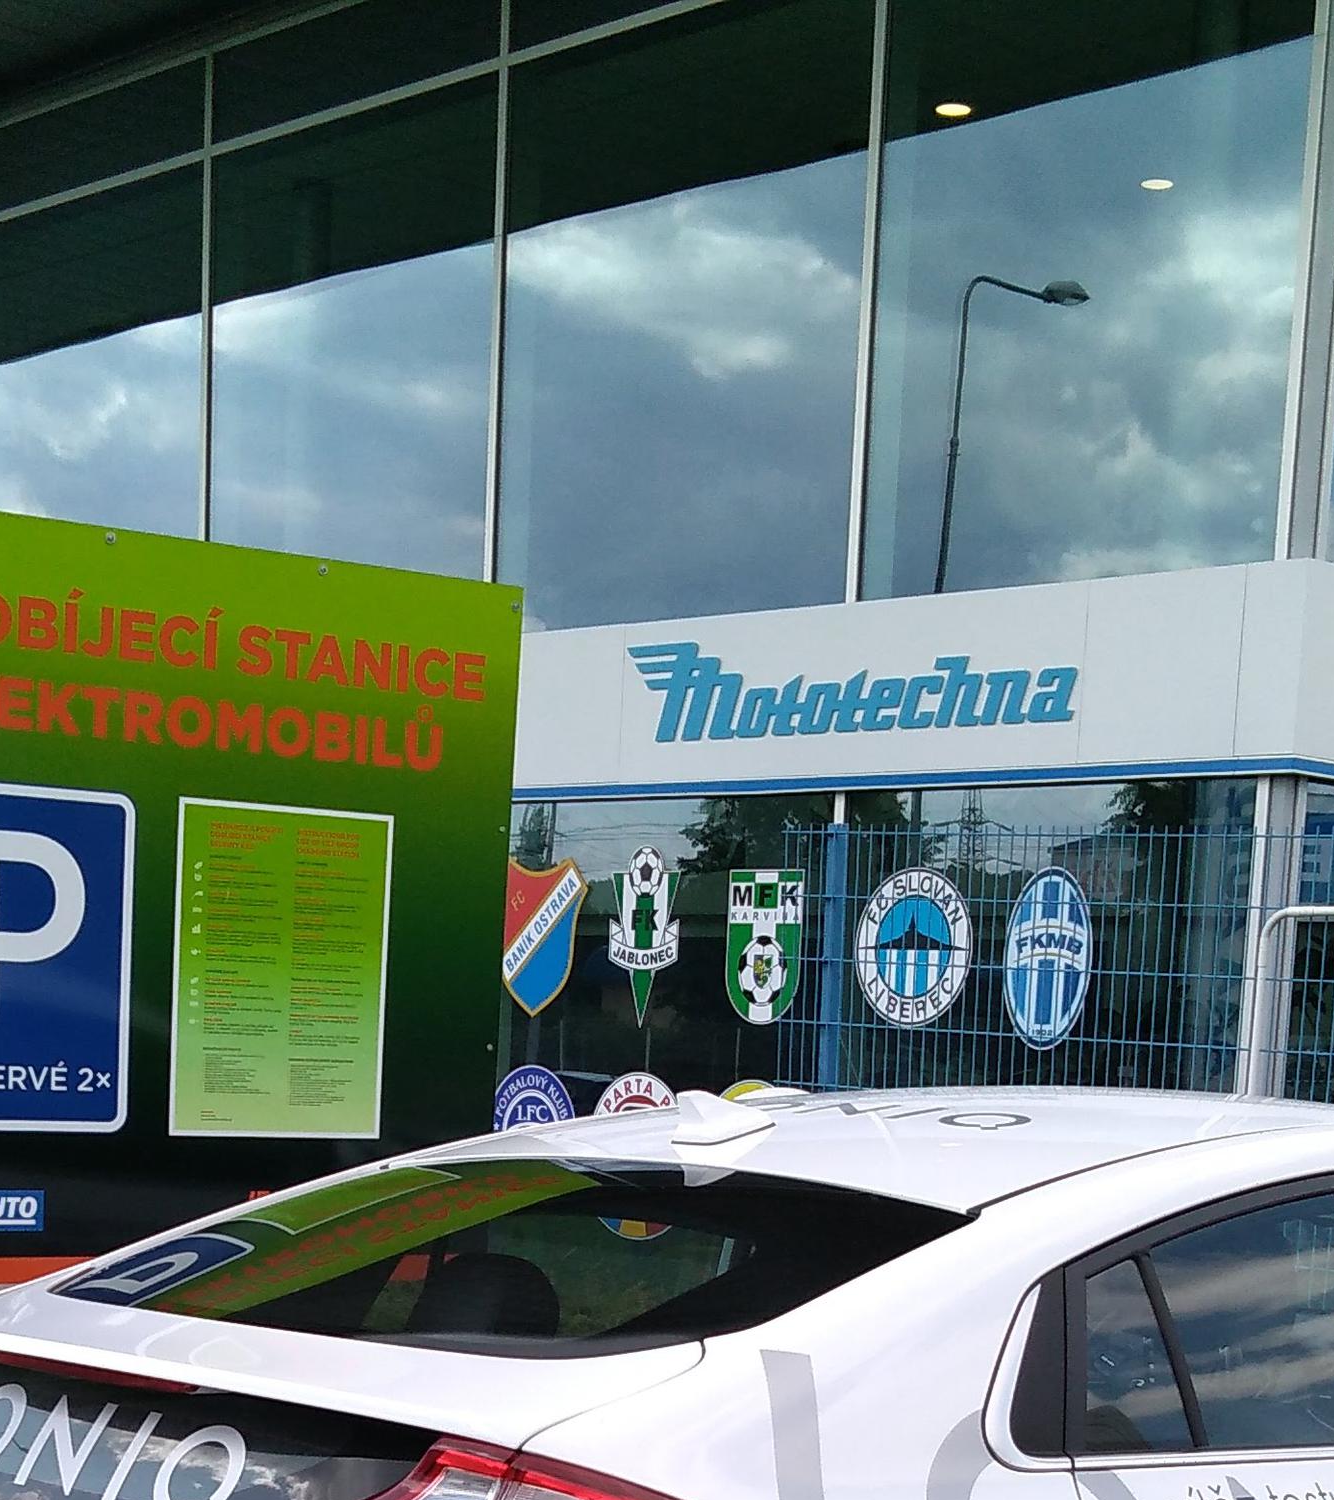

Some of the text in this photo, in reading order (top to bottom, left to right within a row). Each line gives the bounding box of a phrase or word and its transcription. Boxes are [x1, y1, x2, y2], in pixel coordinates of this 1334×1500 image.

[236, 624, 487, 702] STANICE
[627, 640, 1079, 744] Mototechna
[510, 889, 526, 911] FC
[533, 876, 577, 937] OSTRAVA
[732, 884, 800, 908] MFK
[868, 877, 964, 927] FC SLOVAN
[630, 909, 659, 932] FK
[612, 946, 675, 967] JABLONEC
[1015, 932, 1083, 955] FKMB
[866, 976, 955, 1019] LIBEREC
[495, 1074, 570, 1121] FOTBALOVÝ KLUB
[602, 1078, 654, 1113] PARTA
